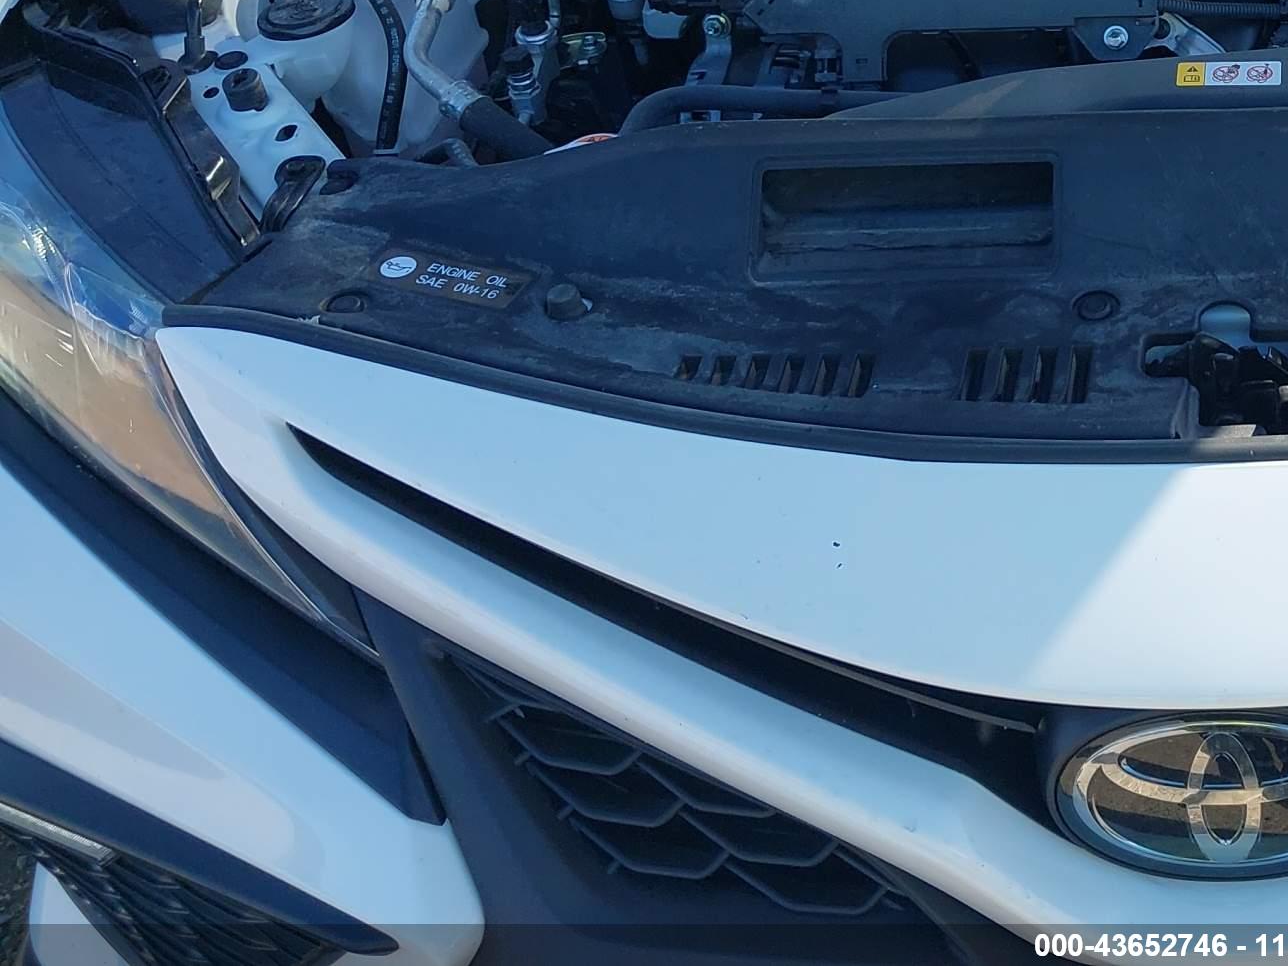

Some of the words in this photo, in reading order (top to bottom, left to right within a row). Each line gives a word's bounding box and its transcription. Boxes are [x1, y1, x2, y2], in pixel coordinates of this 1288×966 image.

[416, 274, 448, 289] SAE
[453, 283, 500, 299] 0W-16
[427, 263, 481, 282] ENGINE
[486, 275, 508, 288] OIL
